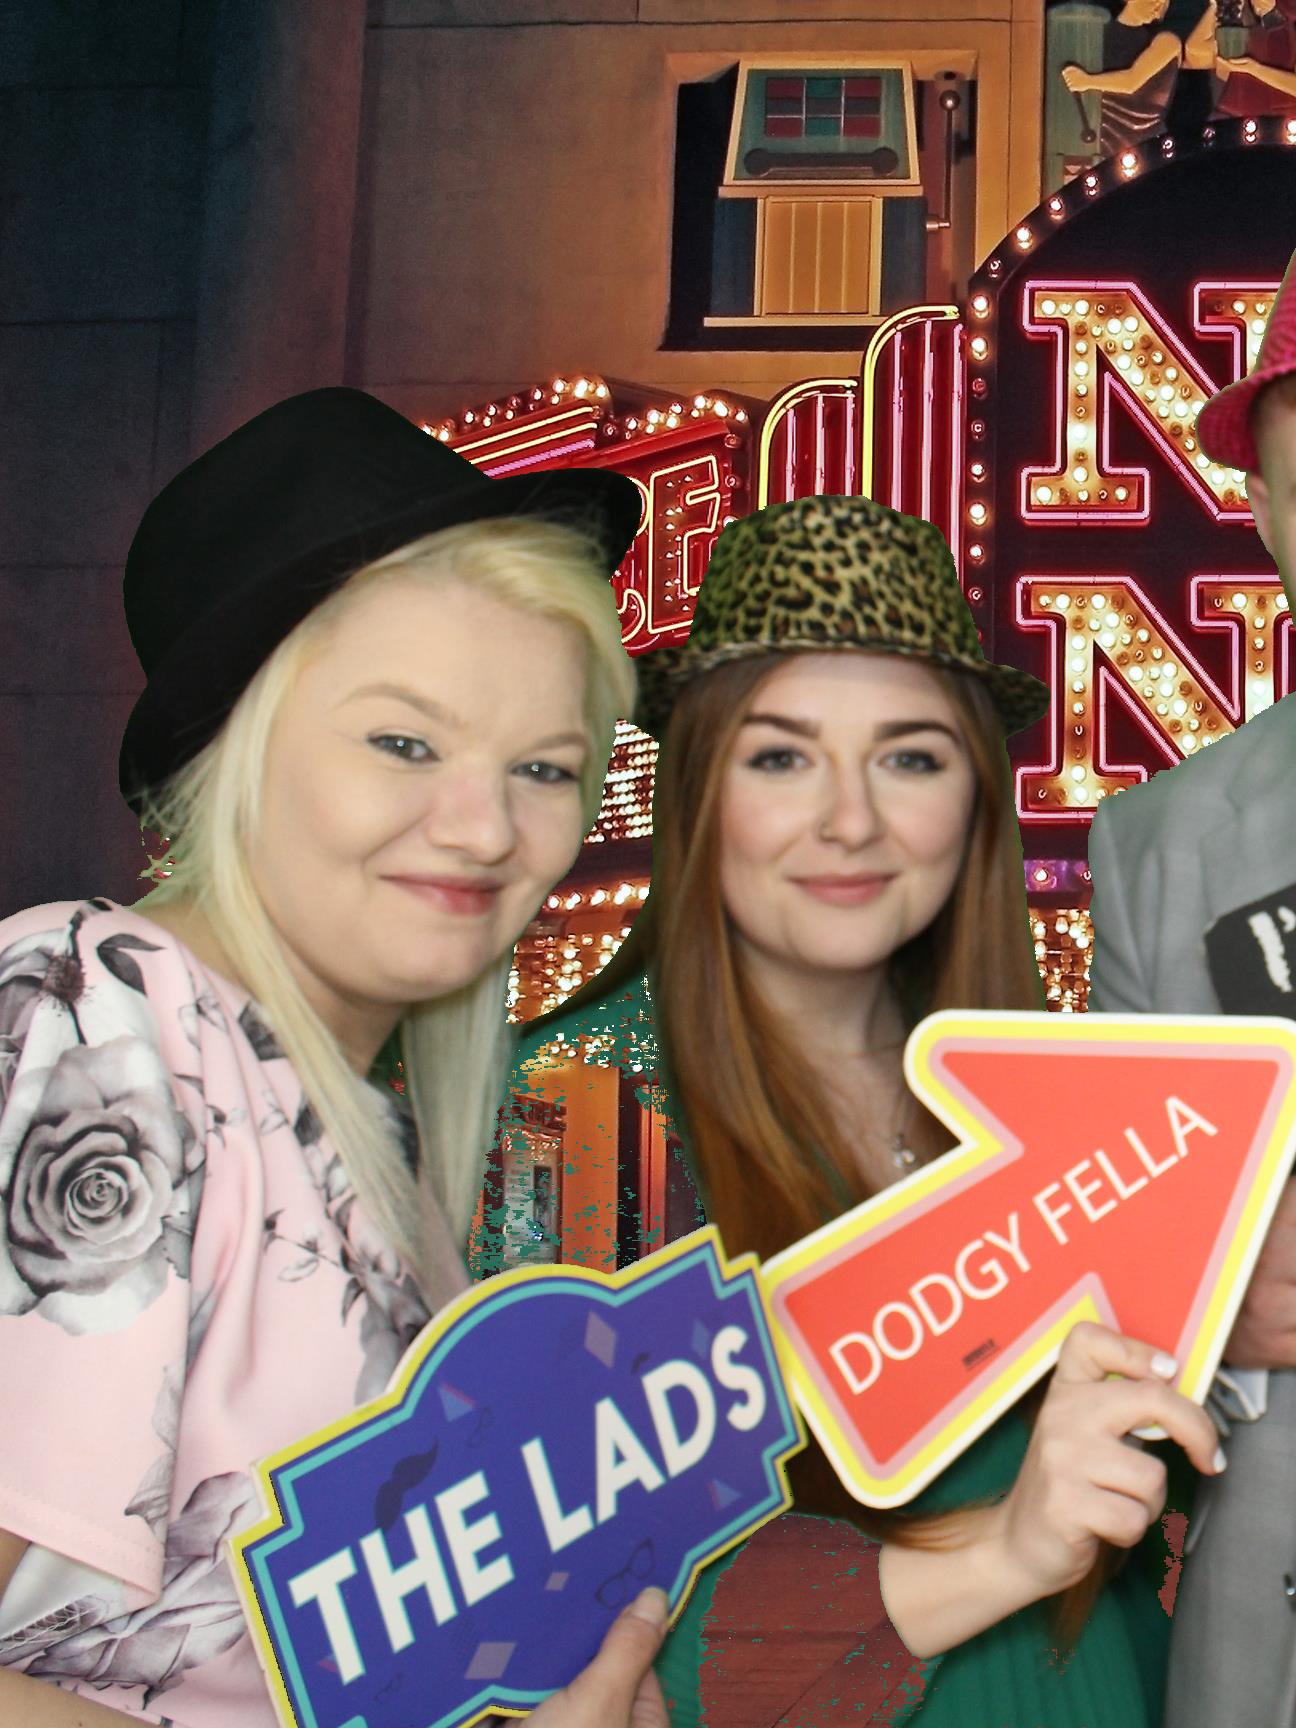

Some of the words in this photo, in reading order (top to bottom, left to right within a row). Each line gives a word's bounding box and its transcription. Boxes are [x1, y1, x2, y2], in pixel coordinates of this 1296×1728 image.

[828, 1211, 1032, 1396] DODGY
[1032, 1095, 1219, 1246] FELLA
[288, 1472, 515, 1686] THE
[520, 1325, 767, 1553] LADS
